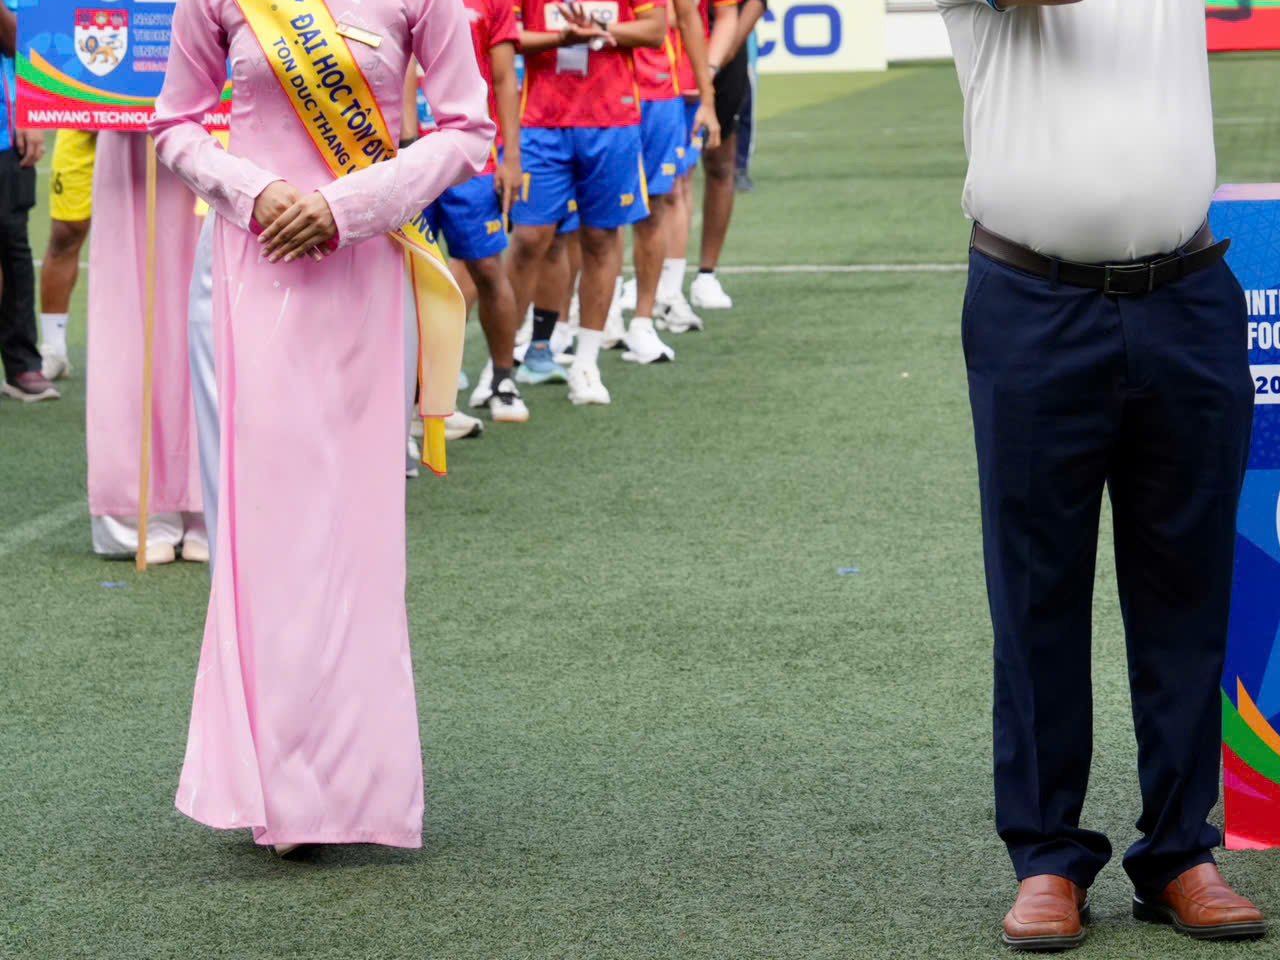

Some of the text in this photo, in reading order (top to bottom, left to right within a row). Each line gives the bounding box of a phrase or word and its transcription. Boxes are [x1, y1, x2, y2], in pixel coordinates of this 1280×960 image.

[28, 110, 91, 123] NANYANG
[272, 35, 351, 166] TON DUC THANG
[290, 13, 328, 55] ĐẠI
[312, 54, 353, 103] HỌC
[340, 97, 379, 142] TÔN
